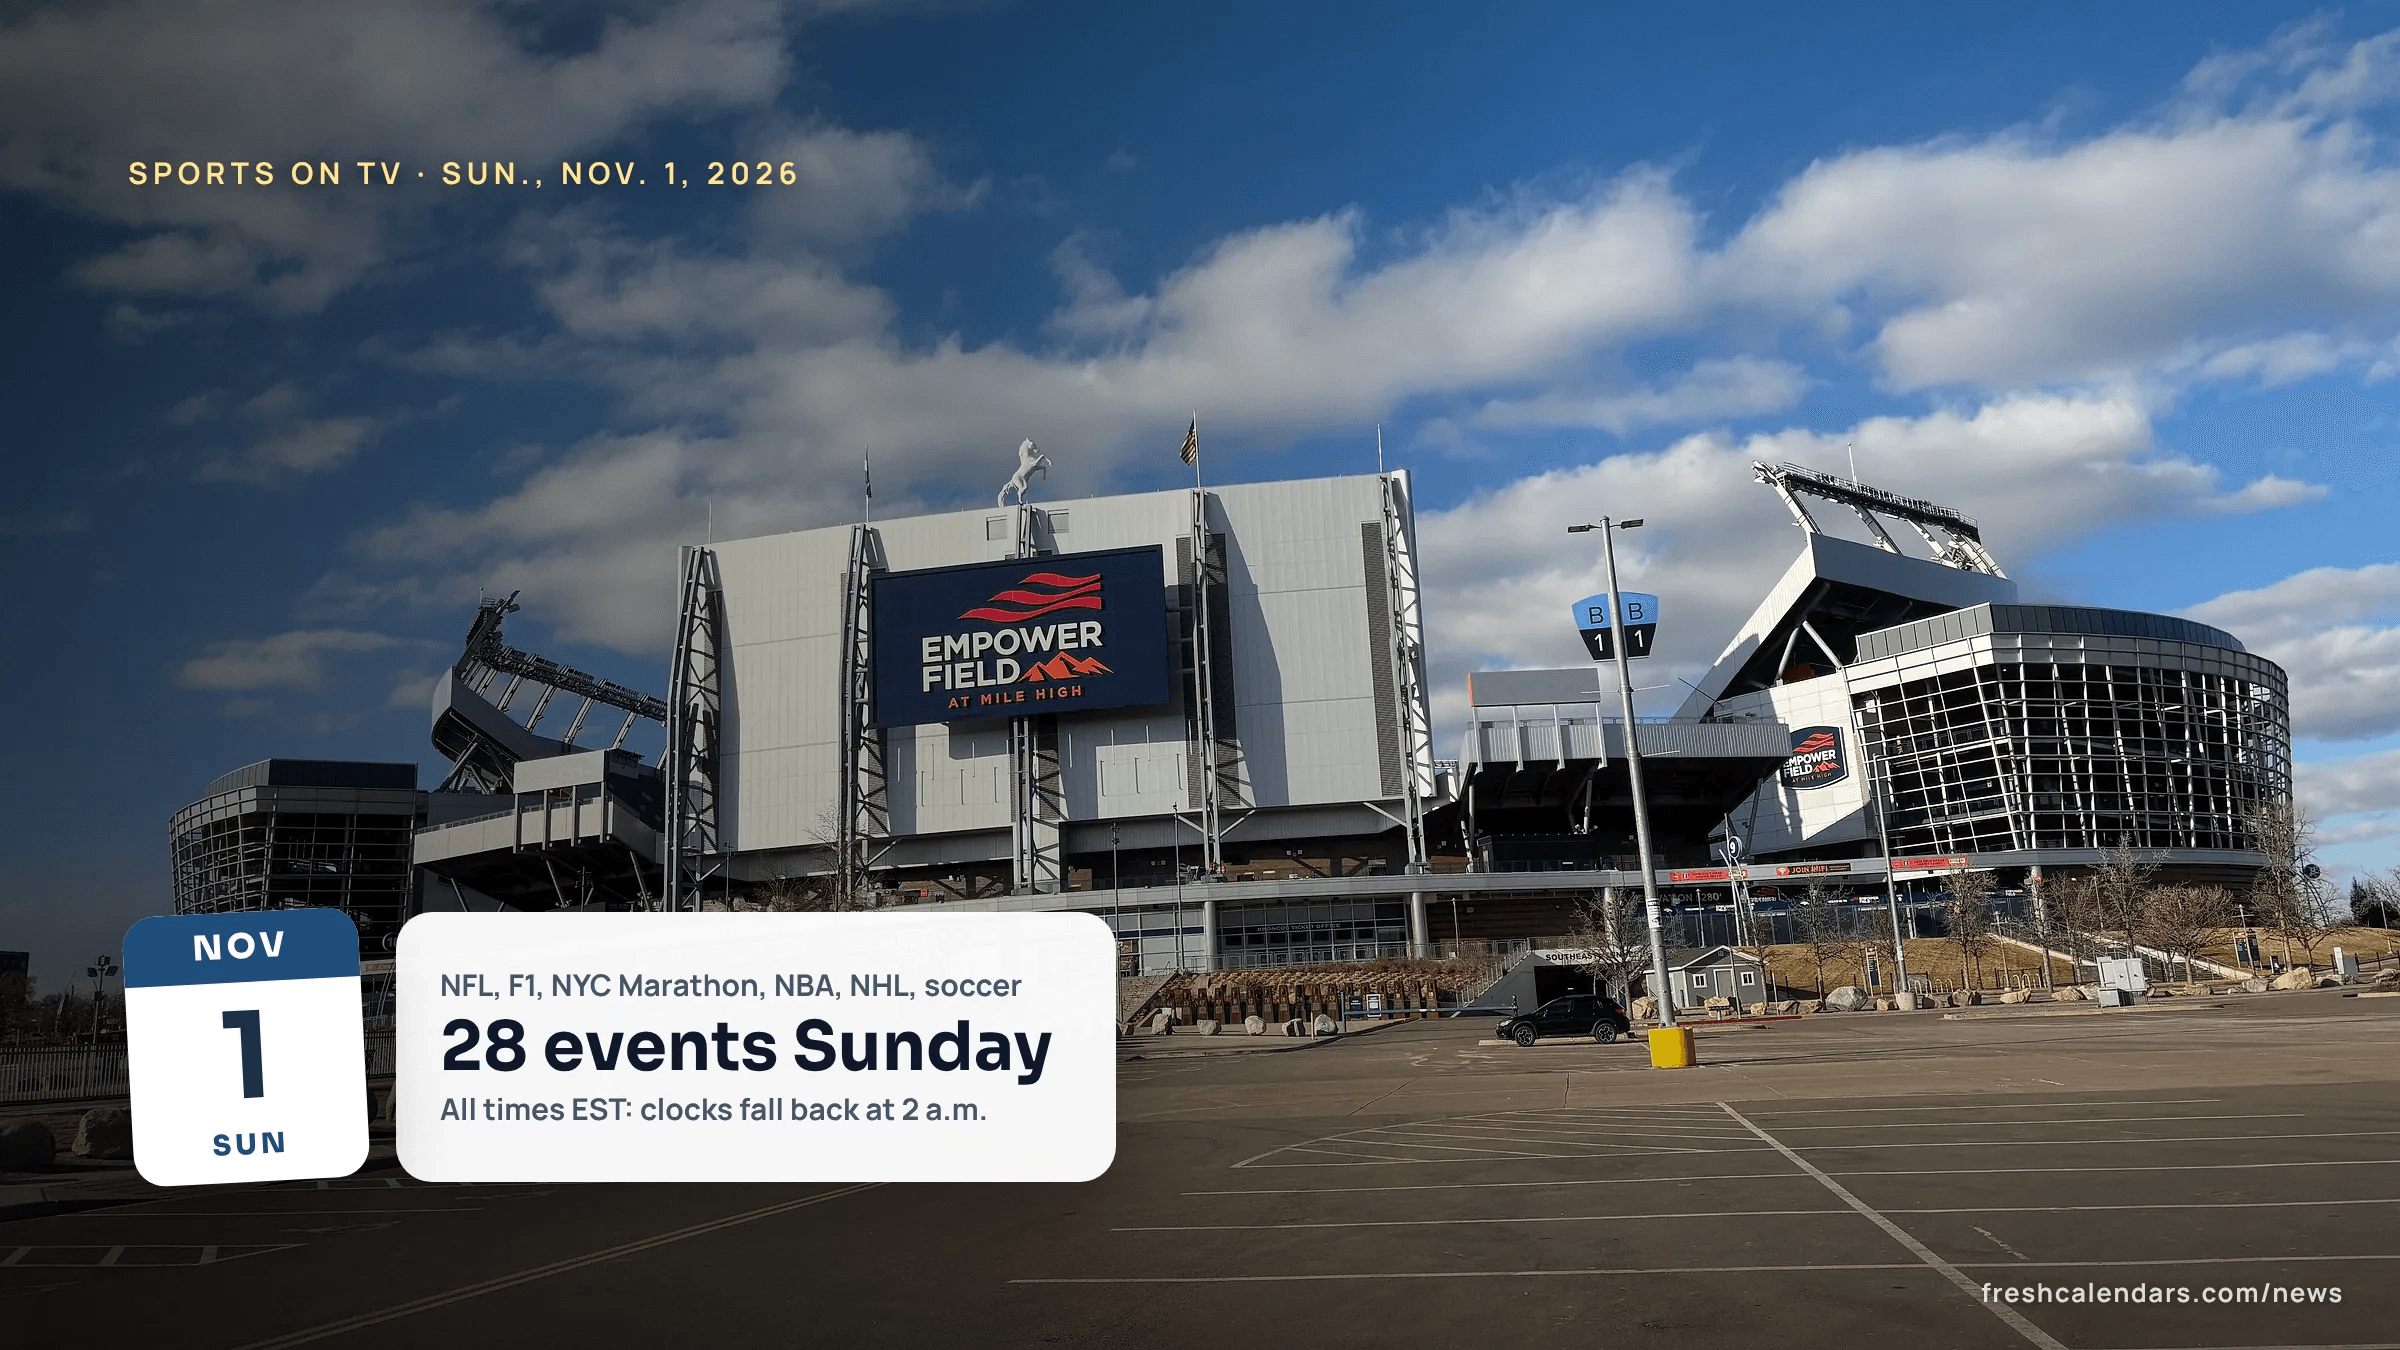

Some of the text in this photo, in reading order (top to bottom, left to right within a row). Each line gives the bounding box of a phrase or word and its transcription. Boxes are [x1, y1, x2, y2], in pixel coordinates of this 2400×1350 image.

[1588, 606, 1604, 624] B
[1628, 602, 1644, 621] B
[921, 620, 1103, 664] EMPOWER
[1594, 633, 1604, 652] 1
[1634, 629, 1644, 648] 1
[922, 658, 1022, 693] FIELD
[947, 685, 1083, 710] AT MILE HIGH
[1783, 764, 1813, 778] FIELD
[1730, 841, 1736, 854] 9
[1791, 866, 1809, 874] JOIN
